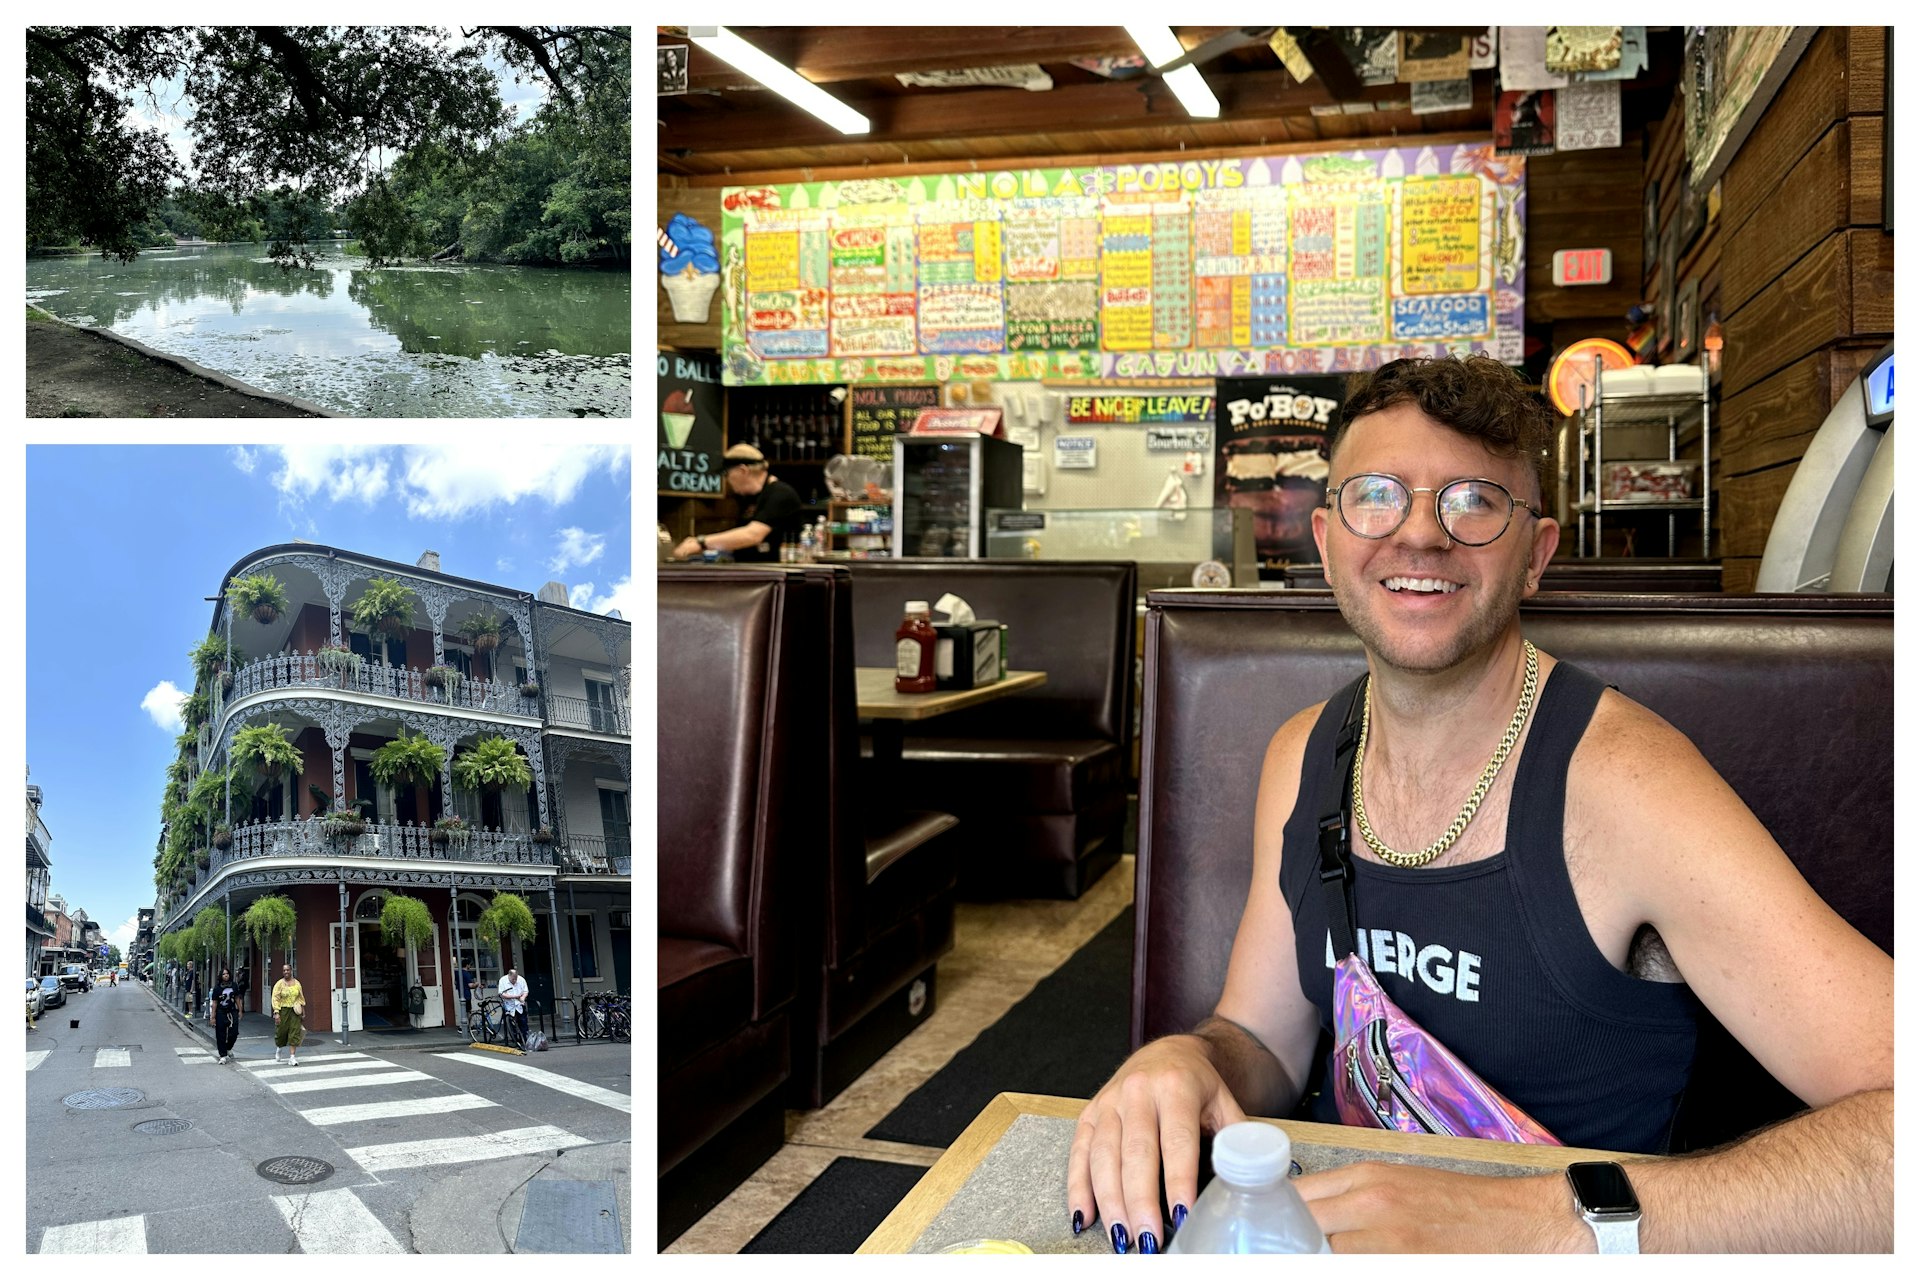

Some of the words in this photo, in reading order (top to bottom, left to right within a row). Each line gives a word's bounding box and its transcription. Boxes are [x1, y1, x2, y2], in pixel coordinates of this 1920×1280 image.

[957, 168, 1084, 200] NOLA
[1115, 159, 1245, 192] POBOYS
[1563, 249, 1606, 283] EXIT
[1395, 298, 1482, 315] SEAFOOD
[1395, 321, 1443, 337] Contain
[675, 357, 722, 384] BALL
[1007, 355, 1048, 379] BUN
[1114, 350, 1219, 377] CAJUN
[1265, 347, 1324, 372] MORE
[854, 389, 887, 405] NOLA
[1070, 396, 1092, 417] BE
[1147, 396, 1211, 421] LEAVE!
[855, 408, 872, 421] ALL
[1226, 393, 1339, 427] Po'BOY
[855, 420, 881, 433] FOOD
[884, 419, 896, 431] IS
[1057, 440, 1093, 449] NOTICE
[1148, 433, 1193, 449] Bourbon
[669, 470, 722, 492] CREAM
